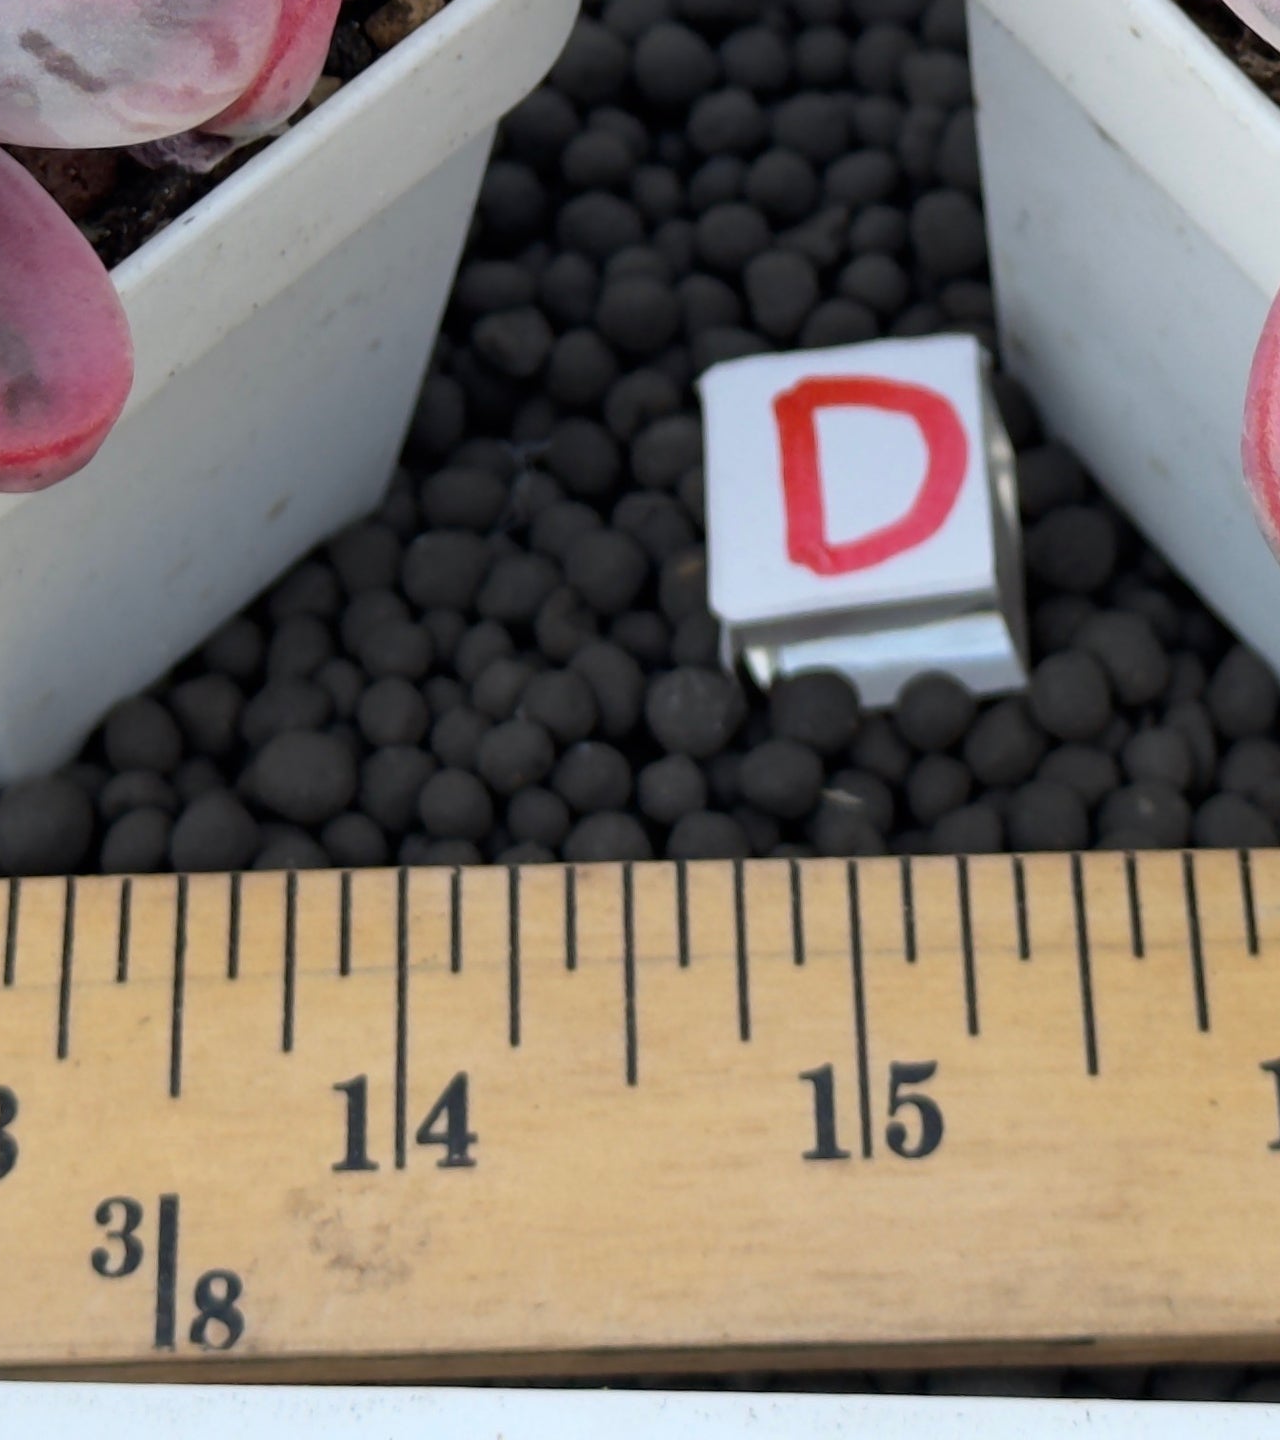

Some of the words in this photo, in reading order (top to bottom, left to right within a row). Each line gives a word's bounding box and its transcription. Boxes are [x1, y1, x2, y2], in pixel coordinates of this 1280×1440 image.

[772, 374, 970, 579] D
[330, 1070, 478, 1172] 14
[797, 1059, 946, 1160] 15
